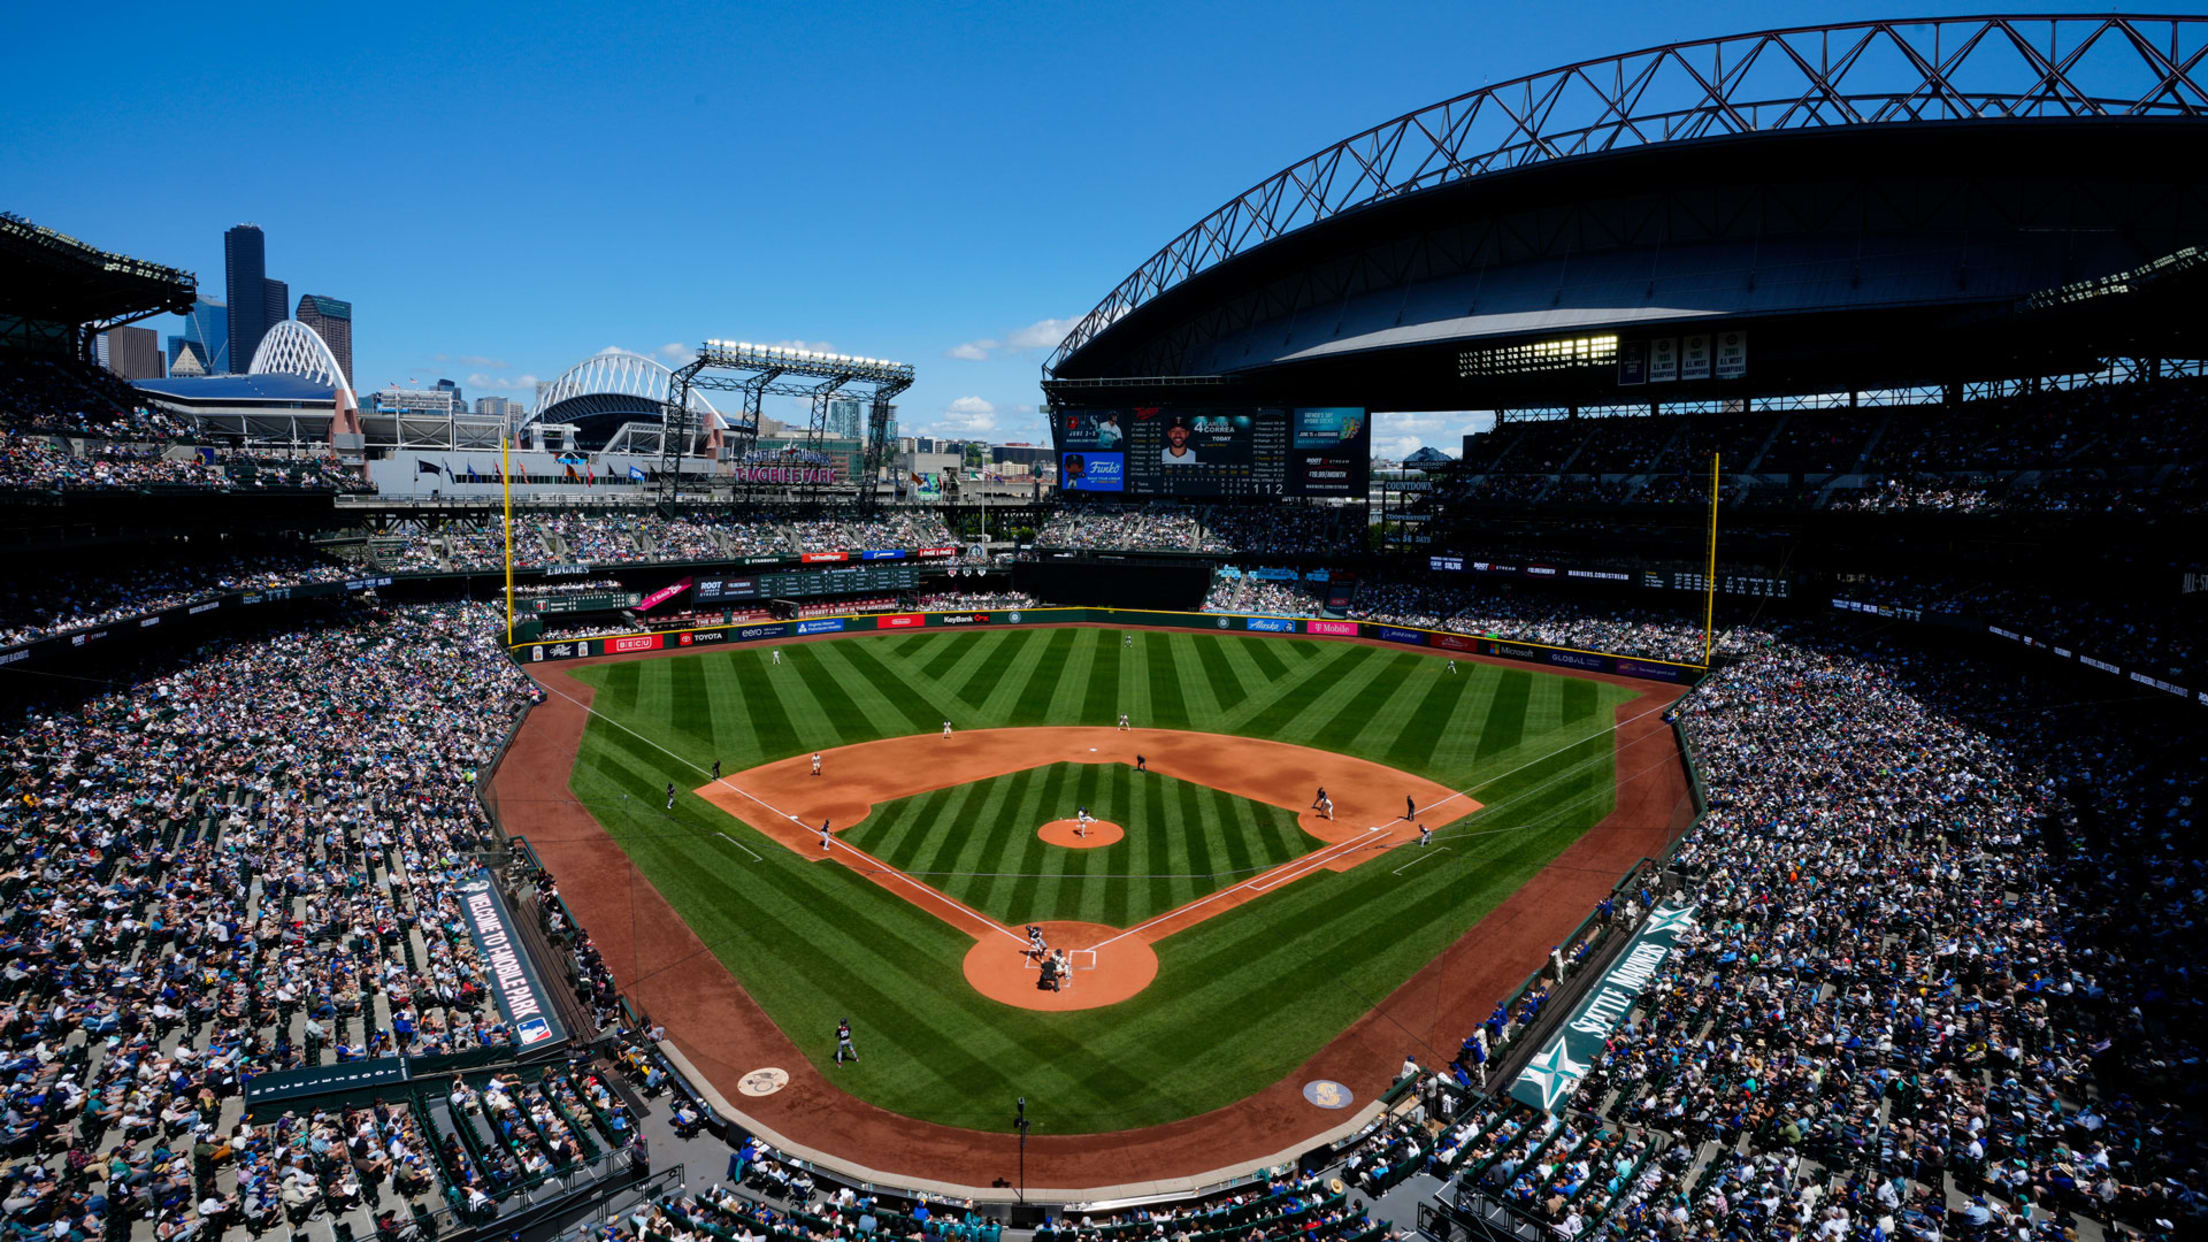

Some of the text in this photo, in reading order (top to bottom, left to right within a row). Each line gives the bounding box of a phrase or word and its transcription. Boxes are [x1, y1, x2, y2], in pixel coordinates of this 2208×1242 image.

[1194, 422, 1203, 433] 4
[735, 467, 838, 484] T-MOBILE PARK
[1275, 484, 1283, 494] 2
[701, 581, 722, 590] ROOT
[944, 615, 973, 625] KeyBank
[1248, 619, 1280, 631] Alaska
[742, 628, 762, 638] eero
[1324, 623, 1350, 634] Mobile
[694, 632, 723, 642] TOYOTA
[1390, 630, 1418, 640] BOEING
[619, 639, 650, 649] BECU
[1500, 646, 1534, 658] Microsoft
[1552, 653, 1585, 665] GLOBAL
[467, 892, 542, 1021] WELCOME TO T-MOBILE PARK
[1569, 941, 1668, 1039] SEATTLE MARINERS
